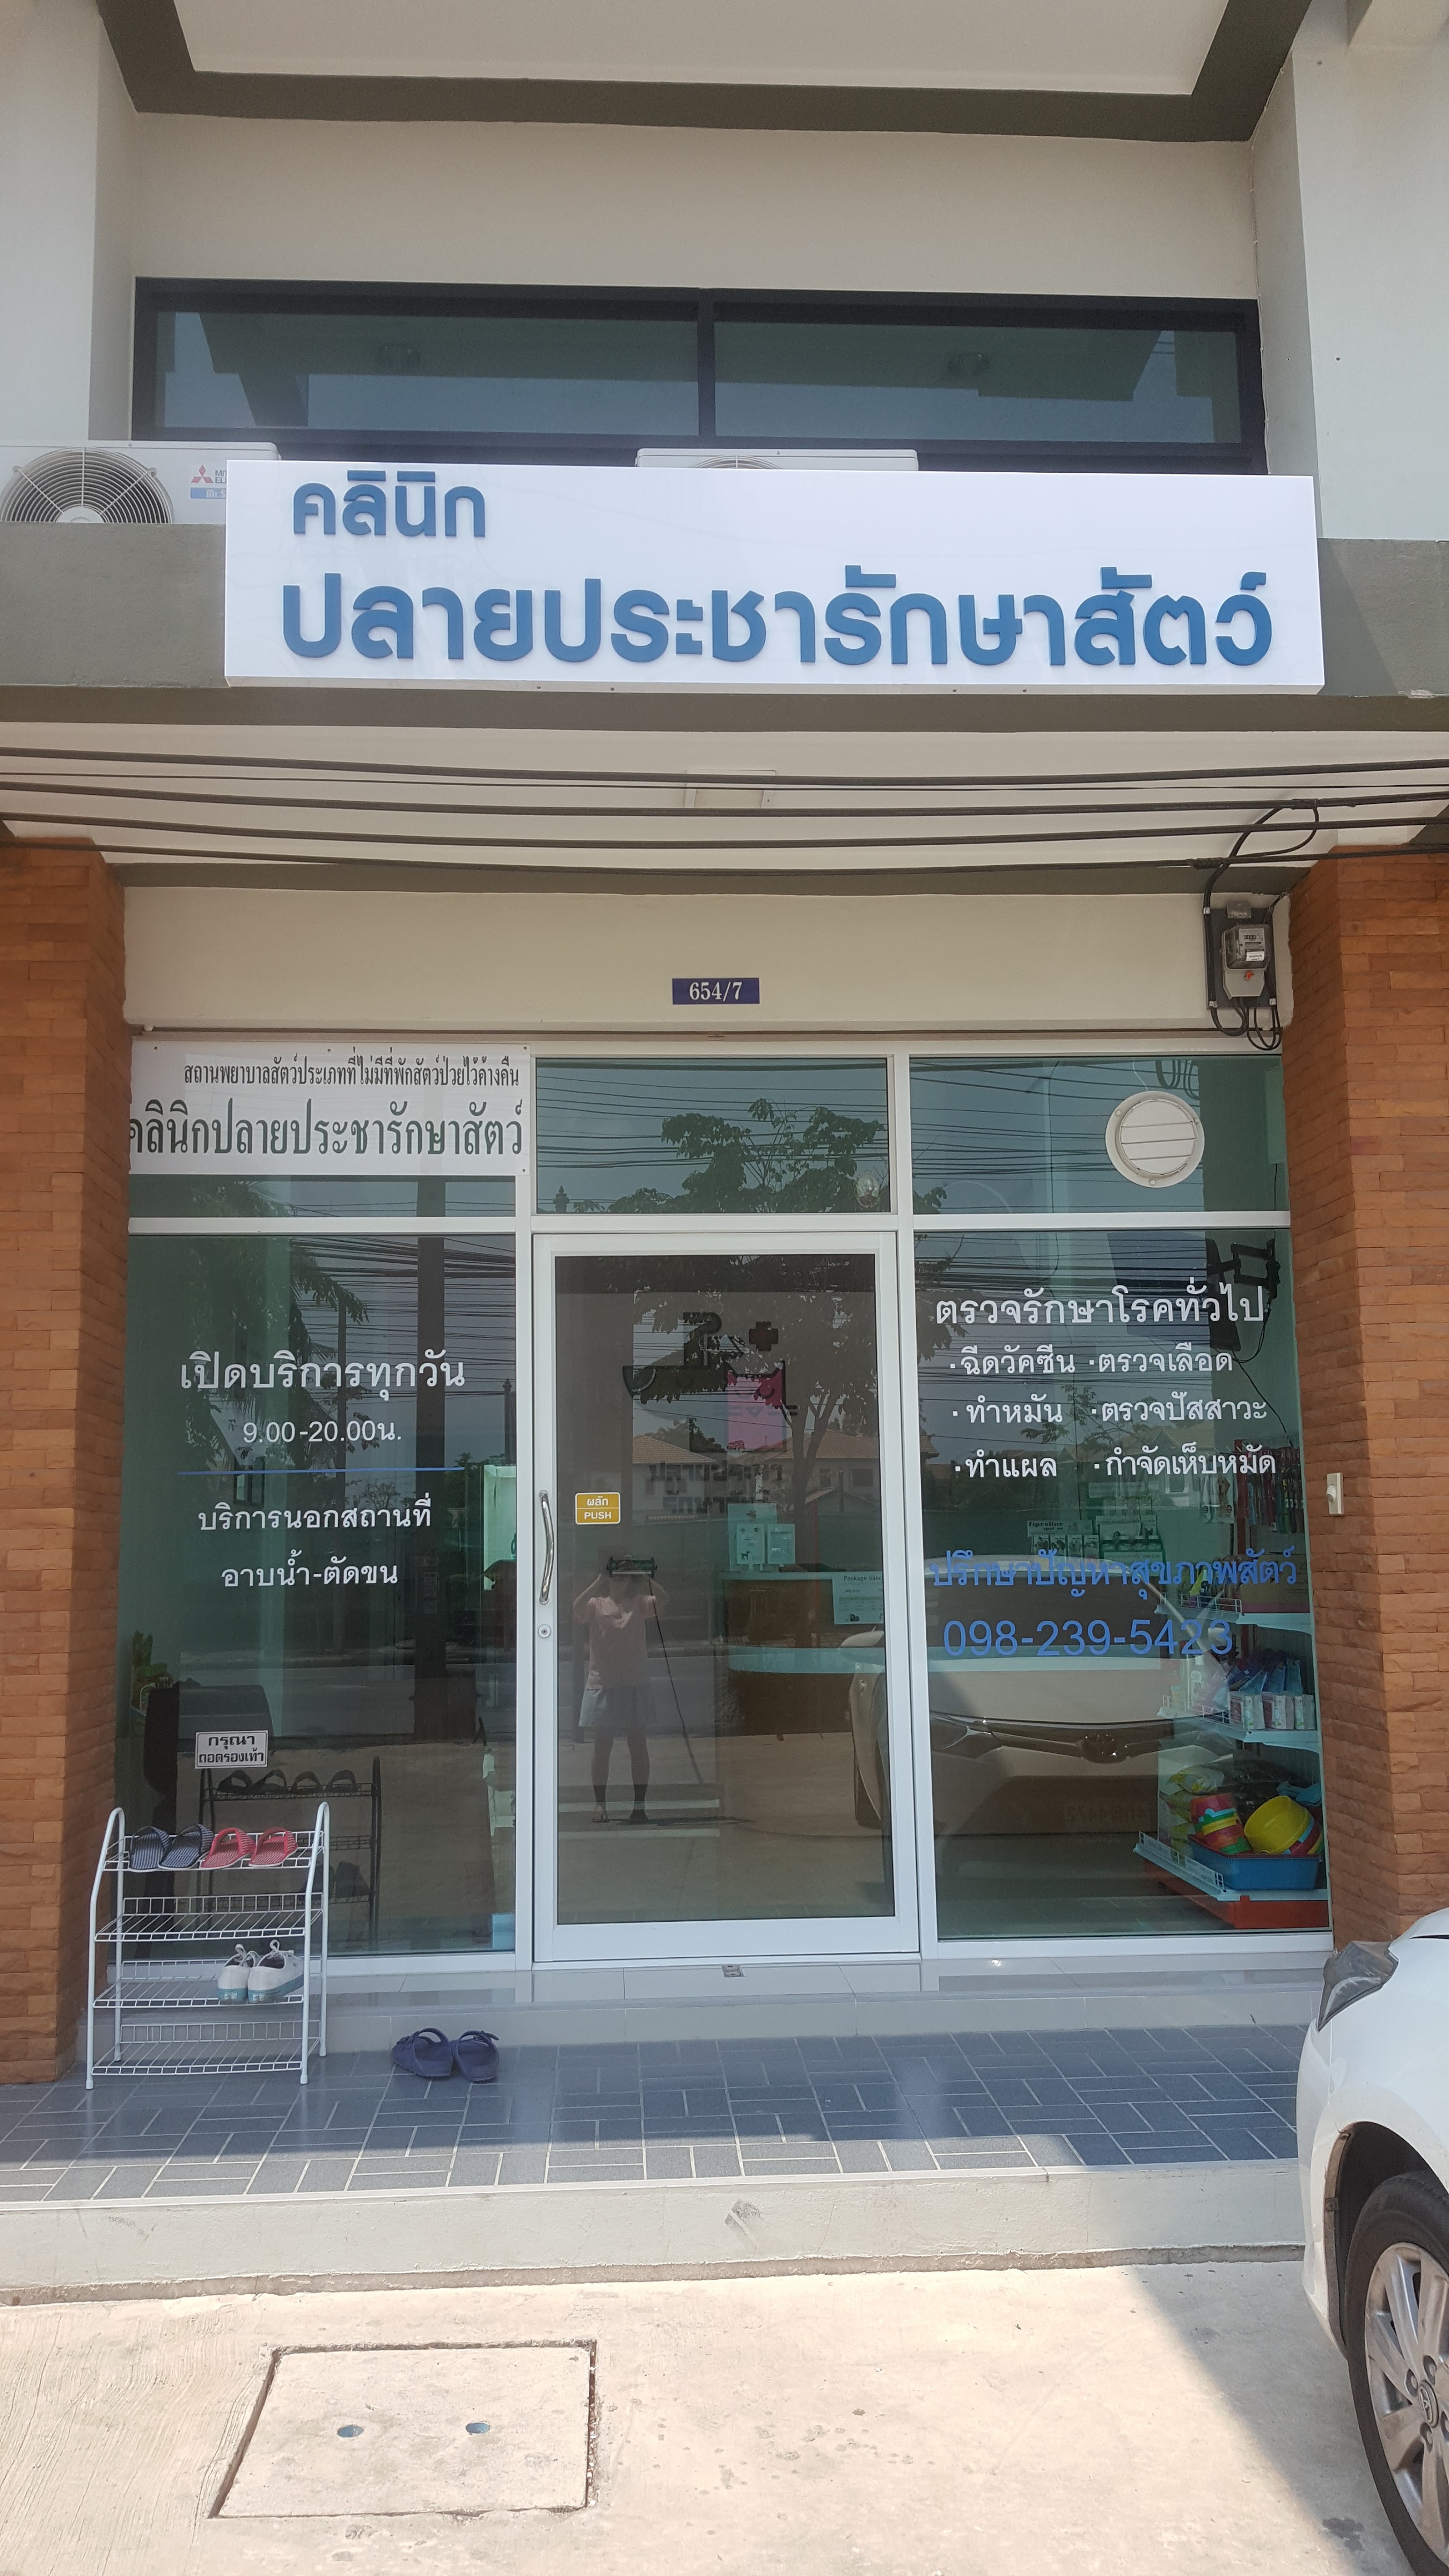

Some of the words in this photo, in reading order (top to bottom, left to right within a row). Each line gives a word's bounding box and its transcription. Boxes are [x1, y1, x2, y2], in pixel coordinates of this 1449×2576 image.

[293, 470, 486, 537] คลินิก
[283, 565, 1272, 667] ปลายประชารักษาสัตว์
[689, 981, 743, 1002] 654/7
[130, 1097, 523, 1155] คลินิกปลายประชารักษาสัตว์
[936, 1277, 1264, 1324] ตรวจรักษาโรคทั่วไป
[181, 1348, 466, 1401] เปิดบริการทุกวัน
[960, 1344, 1076, 1375] ฉีดวัคซีน
[1098, 1342, 1233, 1373] ตรวจเลือด
[966, 1393, 1063, 1424] ทำหมัน
[1102, 1391, 1268, 1422] ตรวจปัสสาวะ
[243, 1420, 402, 1444] 9.00-20.00น.
[965, 1448, 1057, 1478] ทำแผล
[1105, 1441, 1276, 1476] กำจัดเห็บหมัด
[198, 1492, 431, 1531] บริการนอกสถานที่
[584, 1511, 612, 1519] PUSH
[587, 1496, 609, 1506] ผลัก
[221, 1549, 398, 1587] อาบน้ำ-ตัดขน
[929, 1546, 1297, 1600] ปรึกษาปัญหาสุขภาพสัตว์
[943, 1619, 1233, 1656] 098-239-5423
[199, 1747, 264, 1763] ถอดรองเท้า
[208, 1735, 255, 1750] กรุณา
